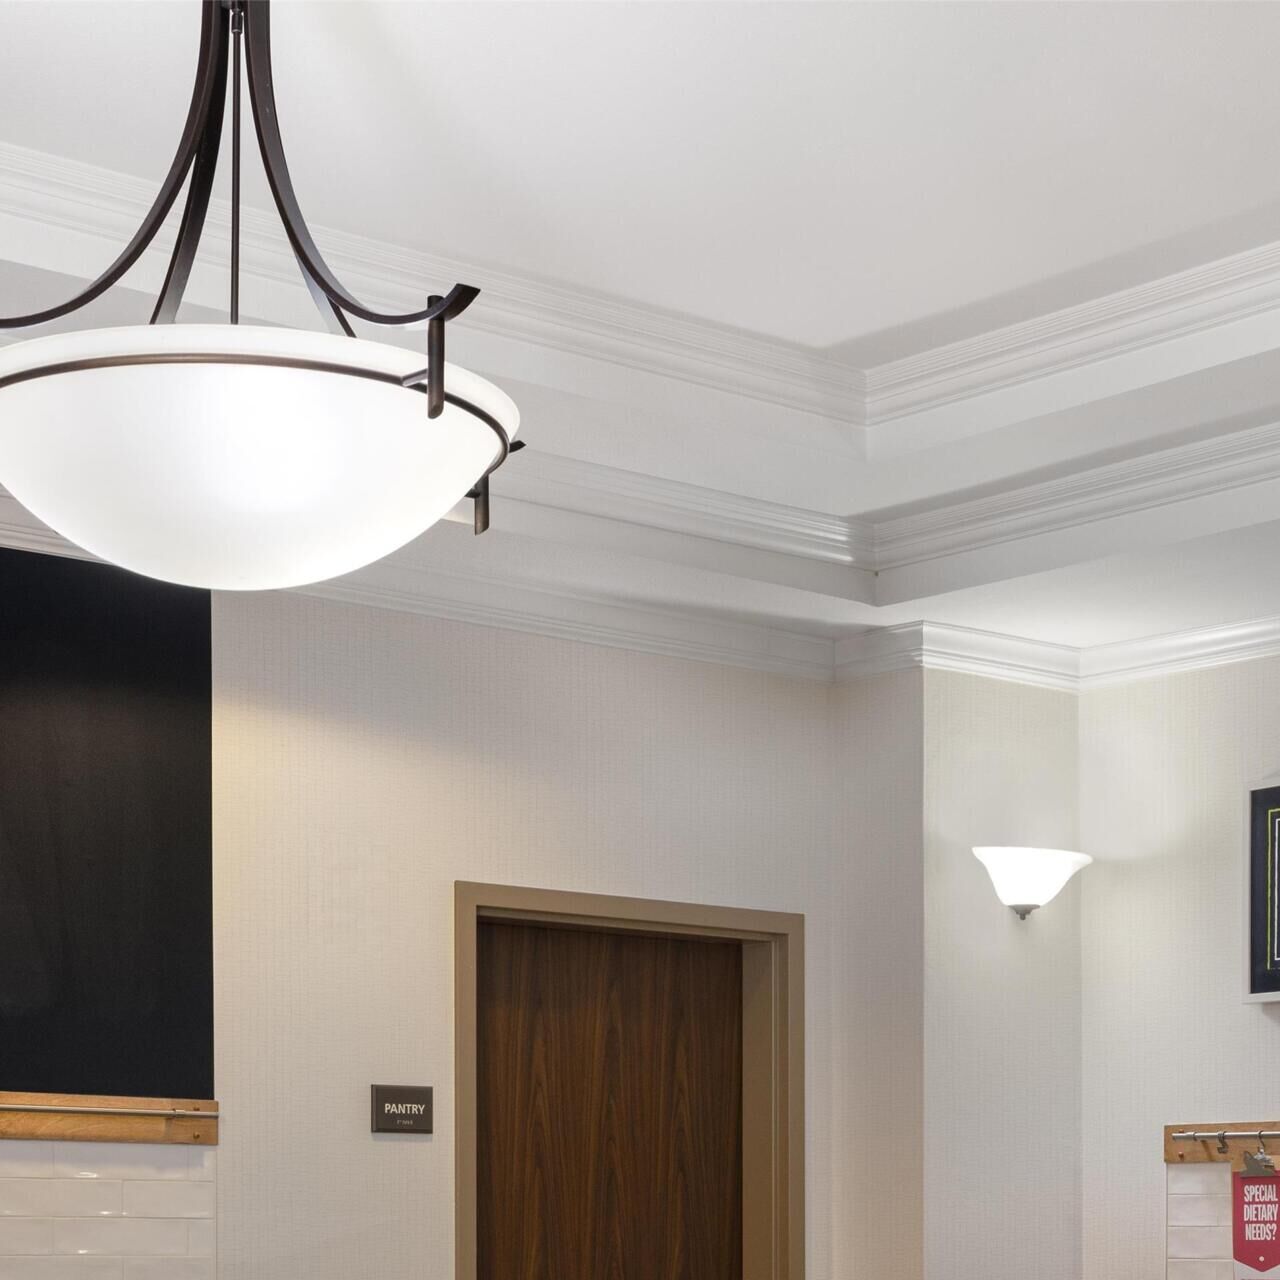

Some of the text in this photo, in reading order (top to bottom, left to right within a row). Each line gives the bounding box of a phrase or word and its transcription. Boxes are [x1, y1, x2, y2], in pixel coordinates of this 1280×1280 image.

[384, 1103, 426, 1115] PANTRY
[1243, 1184, 1279, 1202] SPECIAL
[1243, 1204, 1279, 1222] DIETARY
[1245, 1223, 1277, 1241] NEEDS?
